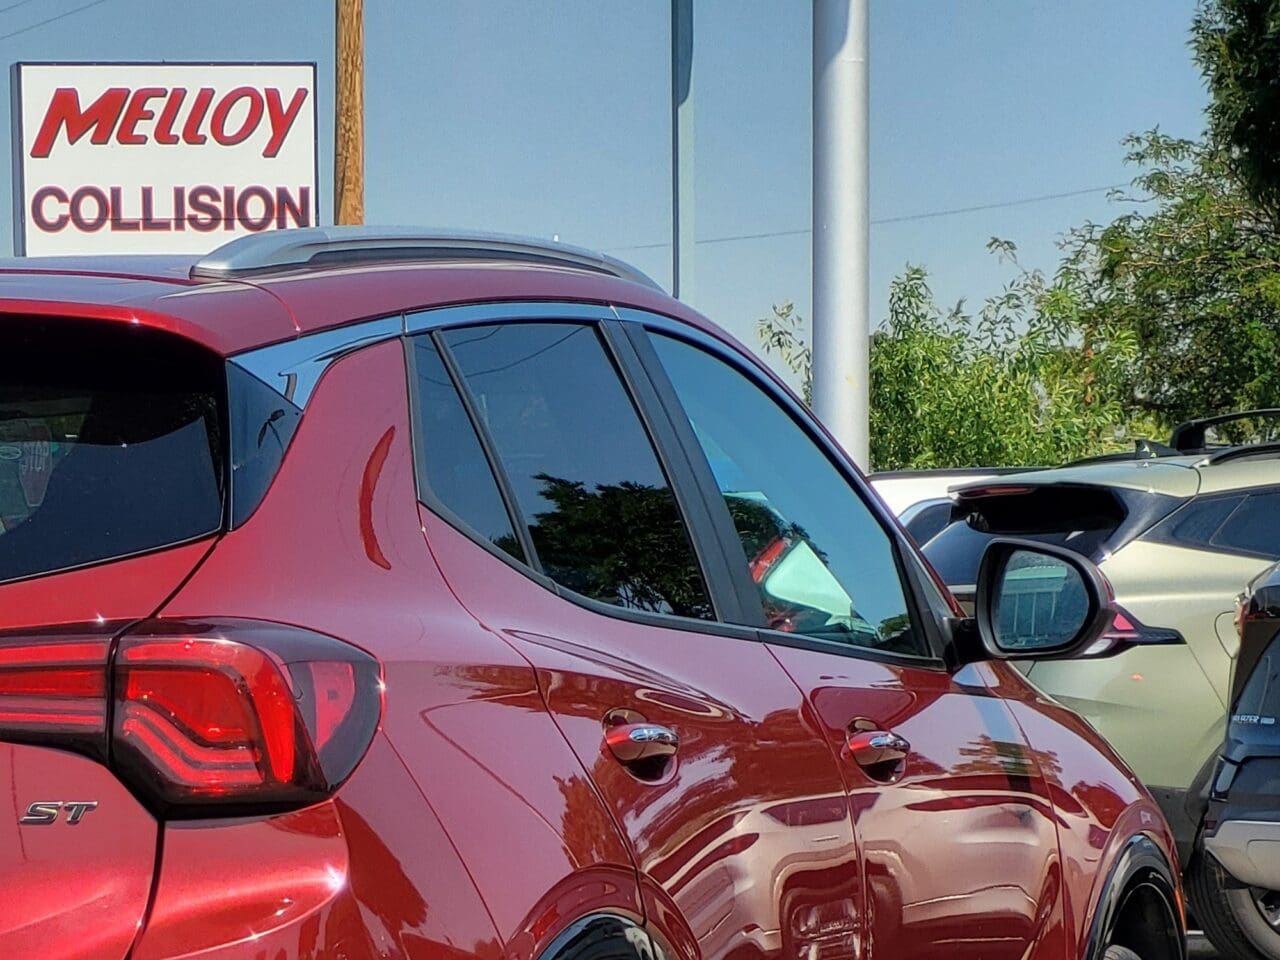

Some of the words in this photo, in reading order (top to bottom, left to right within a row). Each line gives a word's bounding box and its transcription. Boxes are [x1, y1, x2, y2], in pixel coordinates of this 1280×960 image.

[30, 86, 308, 158] MELLOY
[31, 186, 311, 233] COLLISION
[20, 801, 98, 825] ST
